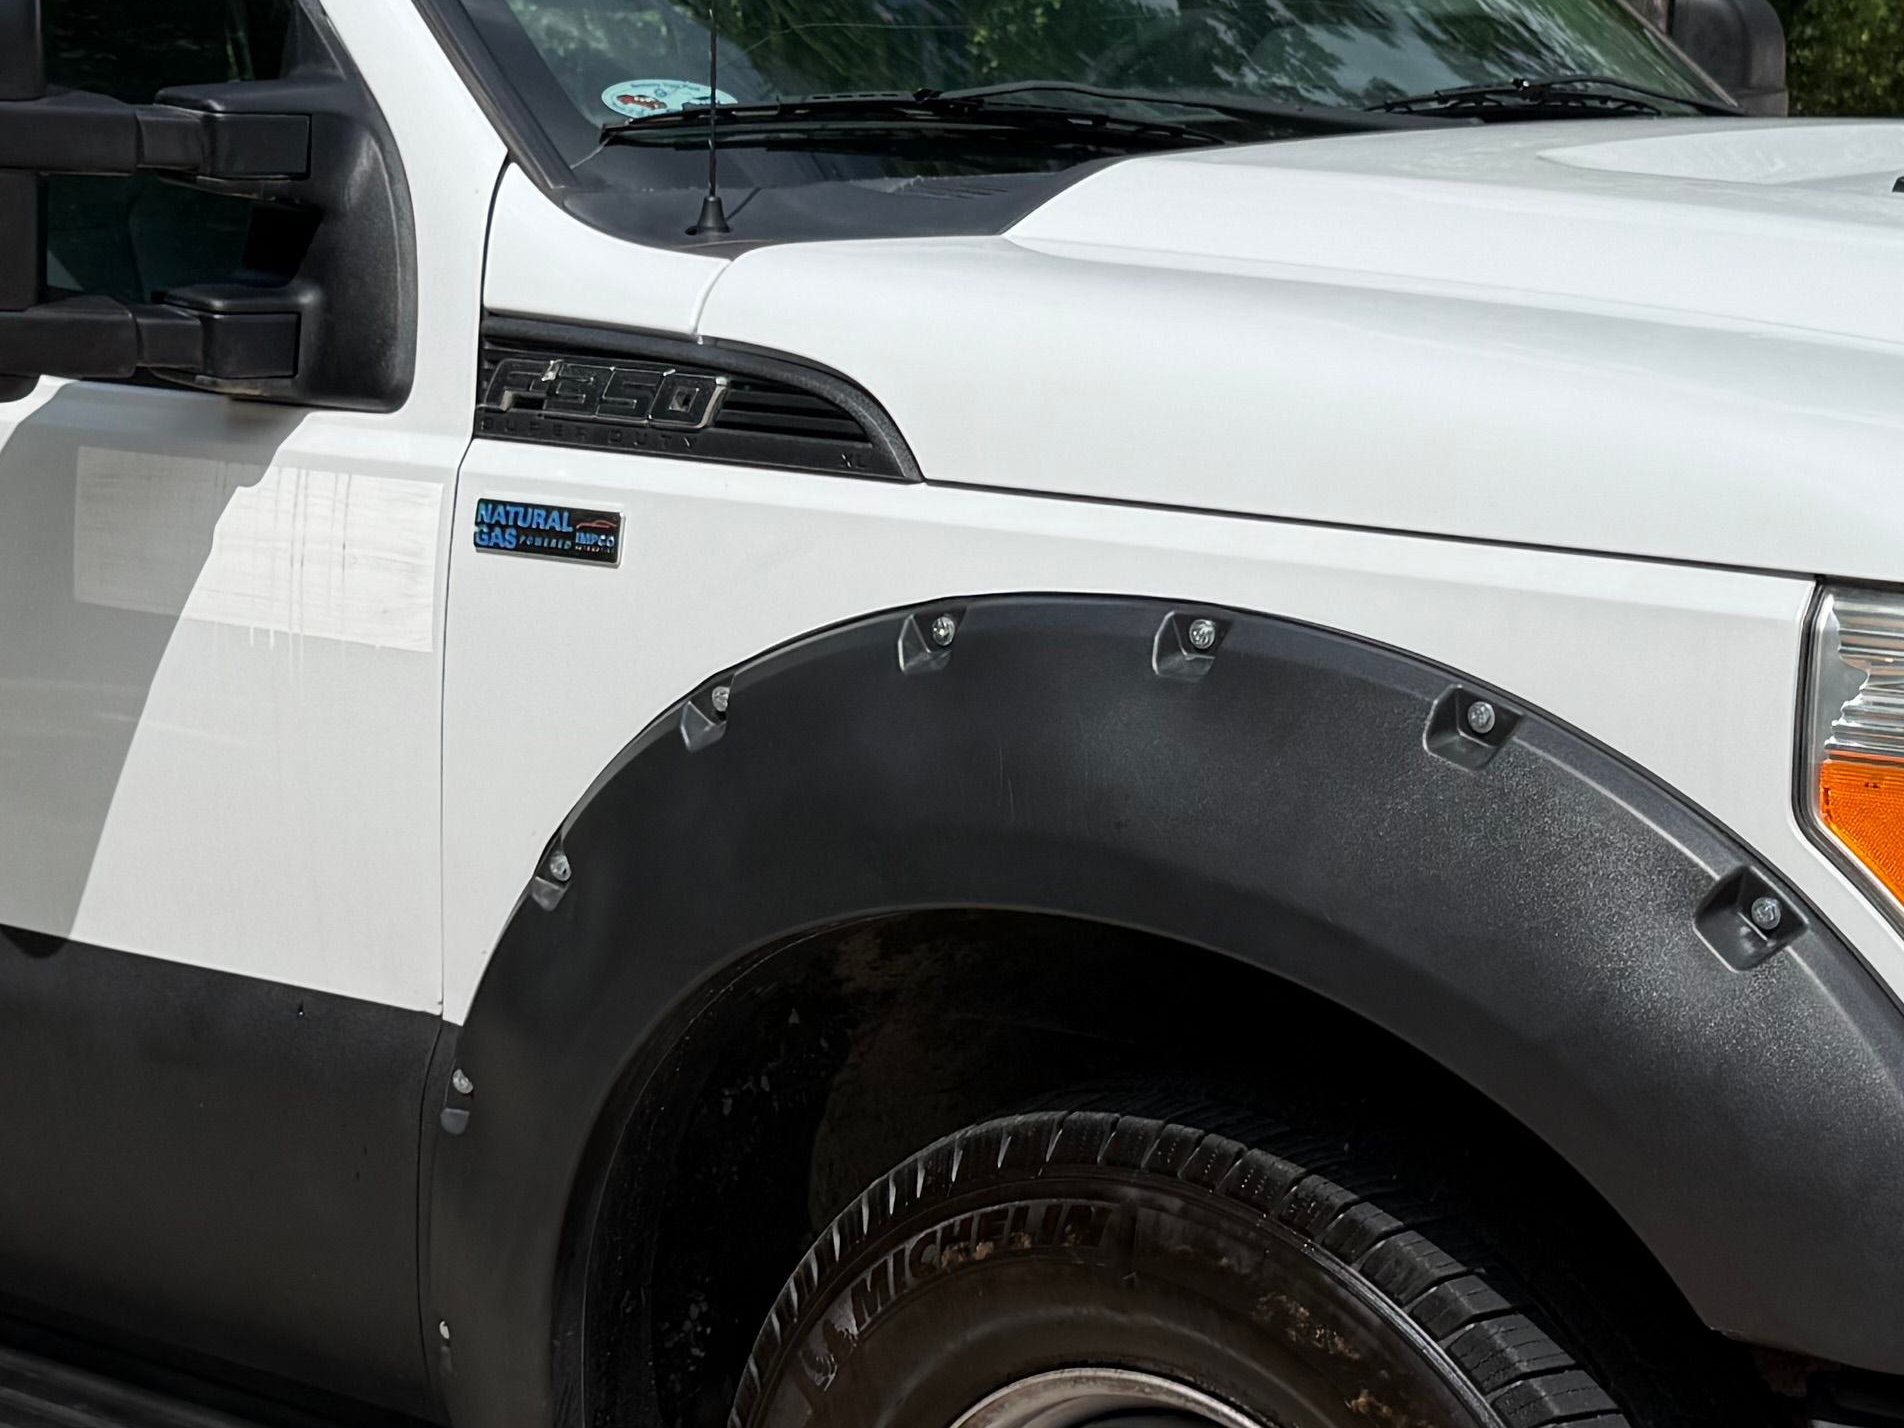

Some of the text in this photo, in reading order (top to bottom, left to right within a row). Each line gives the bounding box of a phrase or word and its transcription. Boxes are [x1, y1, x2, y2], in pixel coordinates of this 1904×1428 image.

[480, 417, 695, 450] SUPER DUTY
[477, 502, 573, 533] NATURAL
[475, 525, 518, 549] GAS
[575, 531, 615, 547] IMPCO
